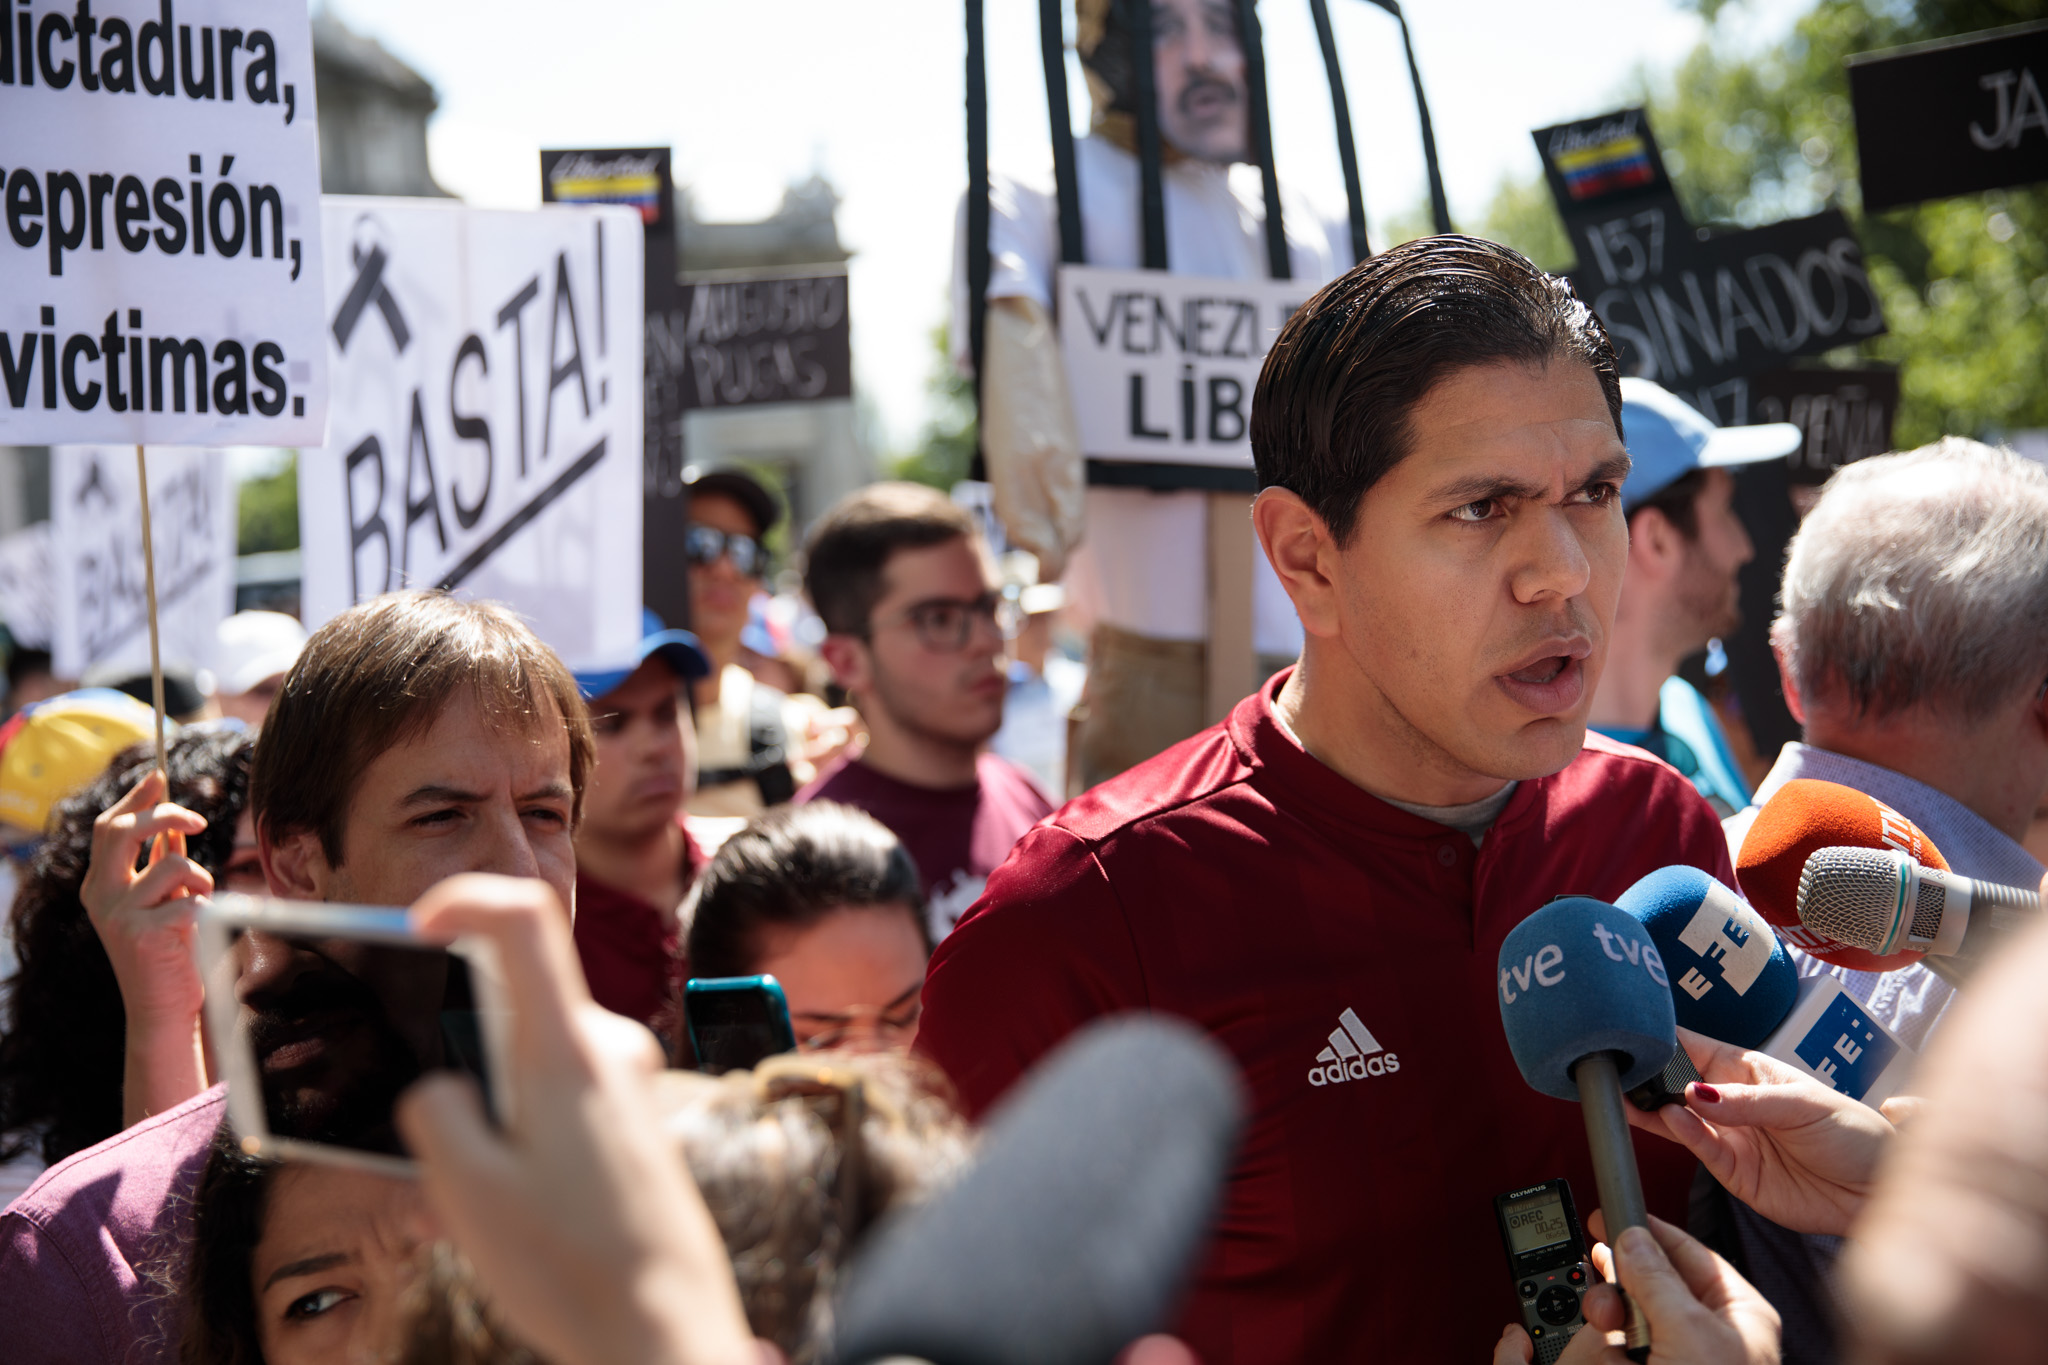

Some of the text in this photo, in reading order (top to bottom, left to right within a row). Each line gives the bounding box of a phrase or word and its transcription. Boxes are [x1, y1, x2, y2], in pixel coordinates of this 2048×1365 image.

[0, 155, 301, 281] epresión,
[1586, 207, 1665, 284] 157
[1075, 287, 1299, 359] VENEZU
[1598, 237, 1889, 383] SINADOS
[345, 212, 608, 602] BASTA!
[1128, 362, 1246, 443] LIB
[1500, 944, 1566, 1005] tve
[1592, 922, 1669, 988] tve
[1308, 1053, 1400, 1087] adidas
[1509, 1184, 1547, 1199] OLYMPUS
[1520, 1209, 1544, 1227] REC
[1522, 1299, 1537, 1308] STOP
